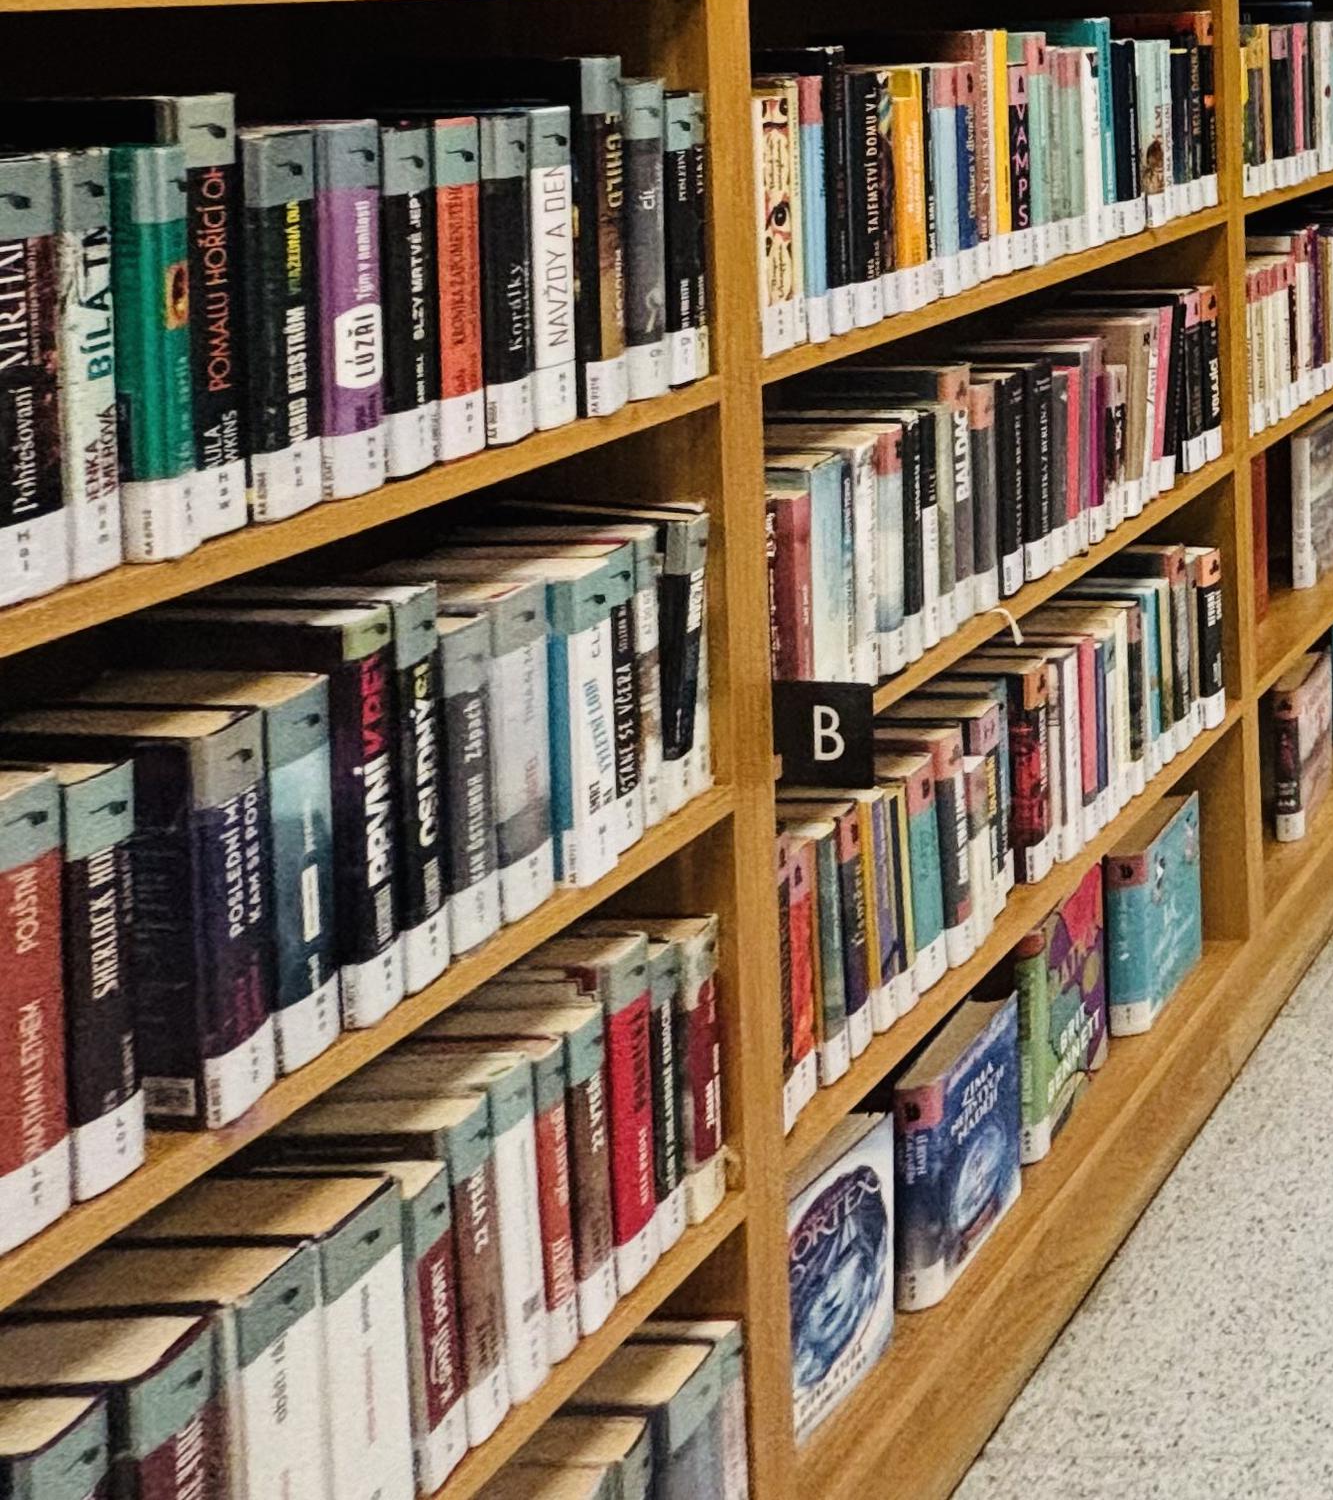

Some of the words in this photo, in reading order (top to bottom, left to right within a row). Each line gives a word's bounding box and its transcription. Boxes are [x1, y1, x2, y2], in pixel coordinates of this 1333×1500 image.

[864, 114, 878, 156] DOMU
[1012, 104, 1030, 228] VAMPS
[551, 221, 568, 240] A
[863, 161, 880, 234] TAJEMSTVÍ
[197, 204, 227, 287] HOŘÍCÍ
[78, 287, 114, 382] BÍLÁ
[207, 291, 231, 392] POMALU
[507, 263, 525, 351] Korálky
[545, 249, 570, 348] NAVŽDY
[284, 305, 308, 395] HEDSTRÖM
[9, 385, 37, 515] Pohřešovaní
[203, 426, 223, 468] AULA
[220, 409, 239, 461] WKINS
[954, 407, 970, 502] BALDAC
[463, 698, 483, 763] Zápach
[812, 705, 846, 761] B
[353, 751, 393, 889] PRVNÍ
[13, 867, 40, 955] POUŠTNÍ
[219, 829, 247, 939] POSLEDNÍ
[88, 891, 120, 1000] SHERLOCK
[790, 1172, 880, 1261] ORTEX
